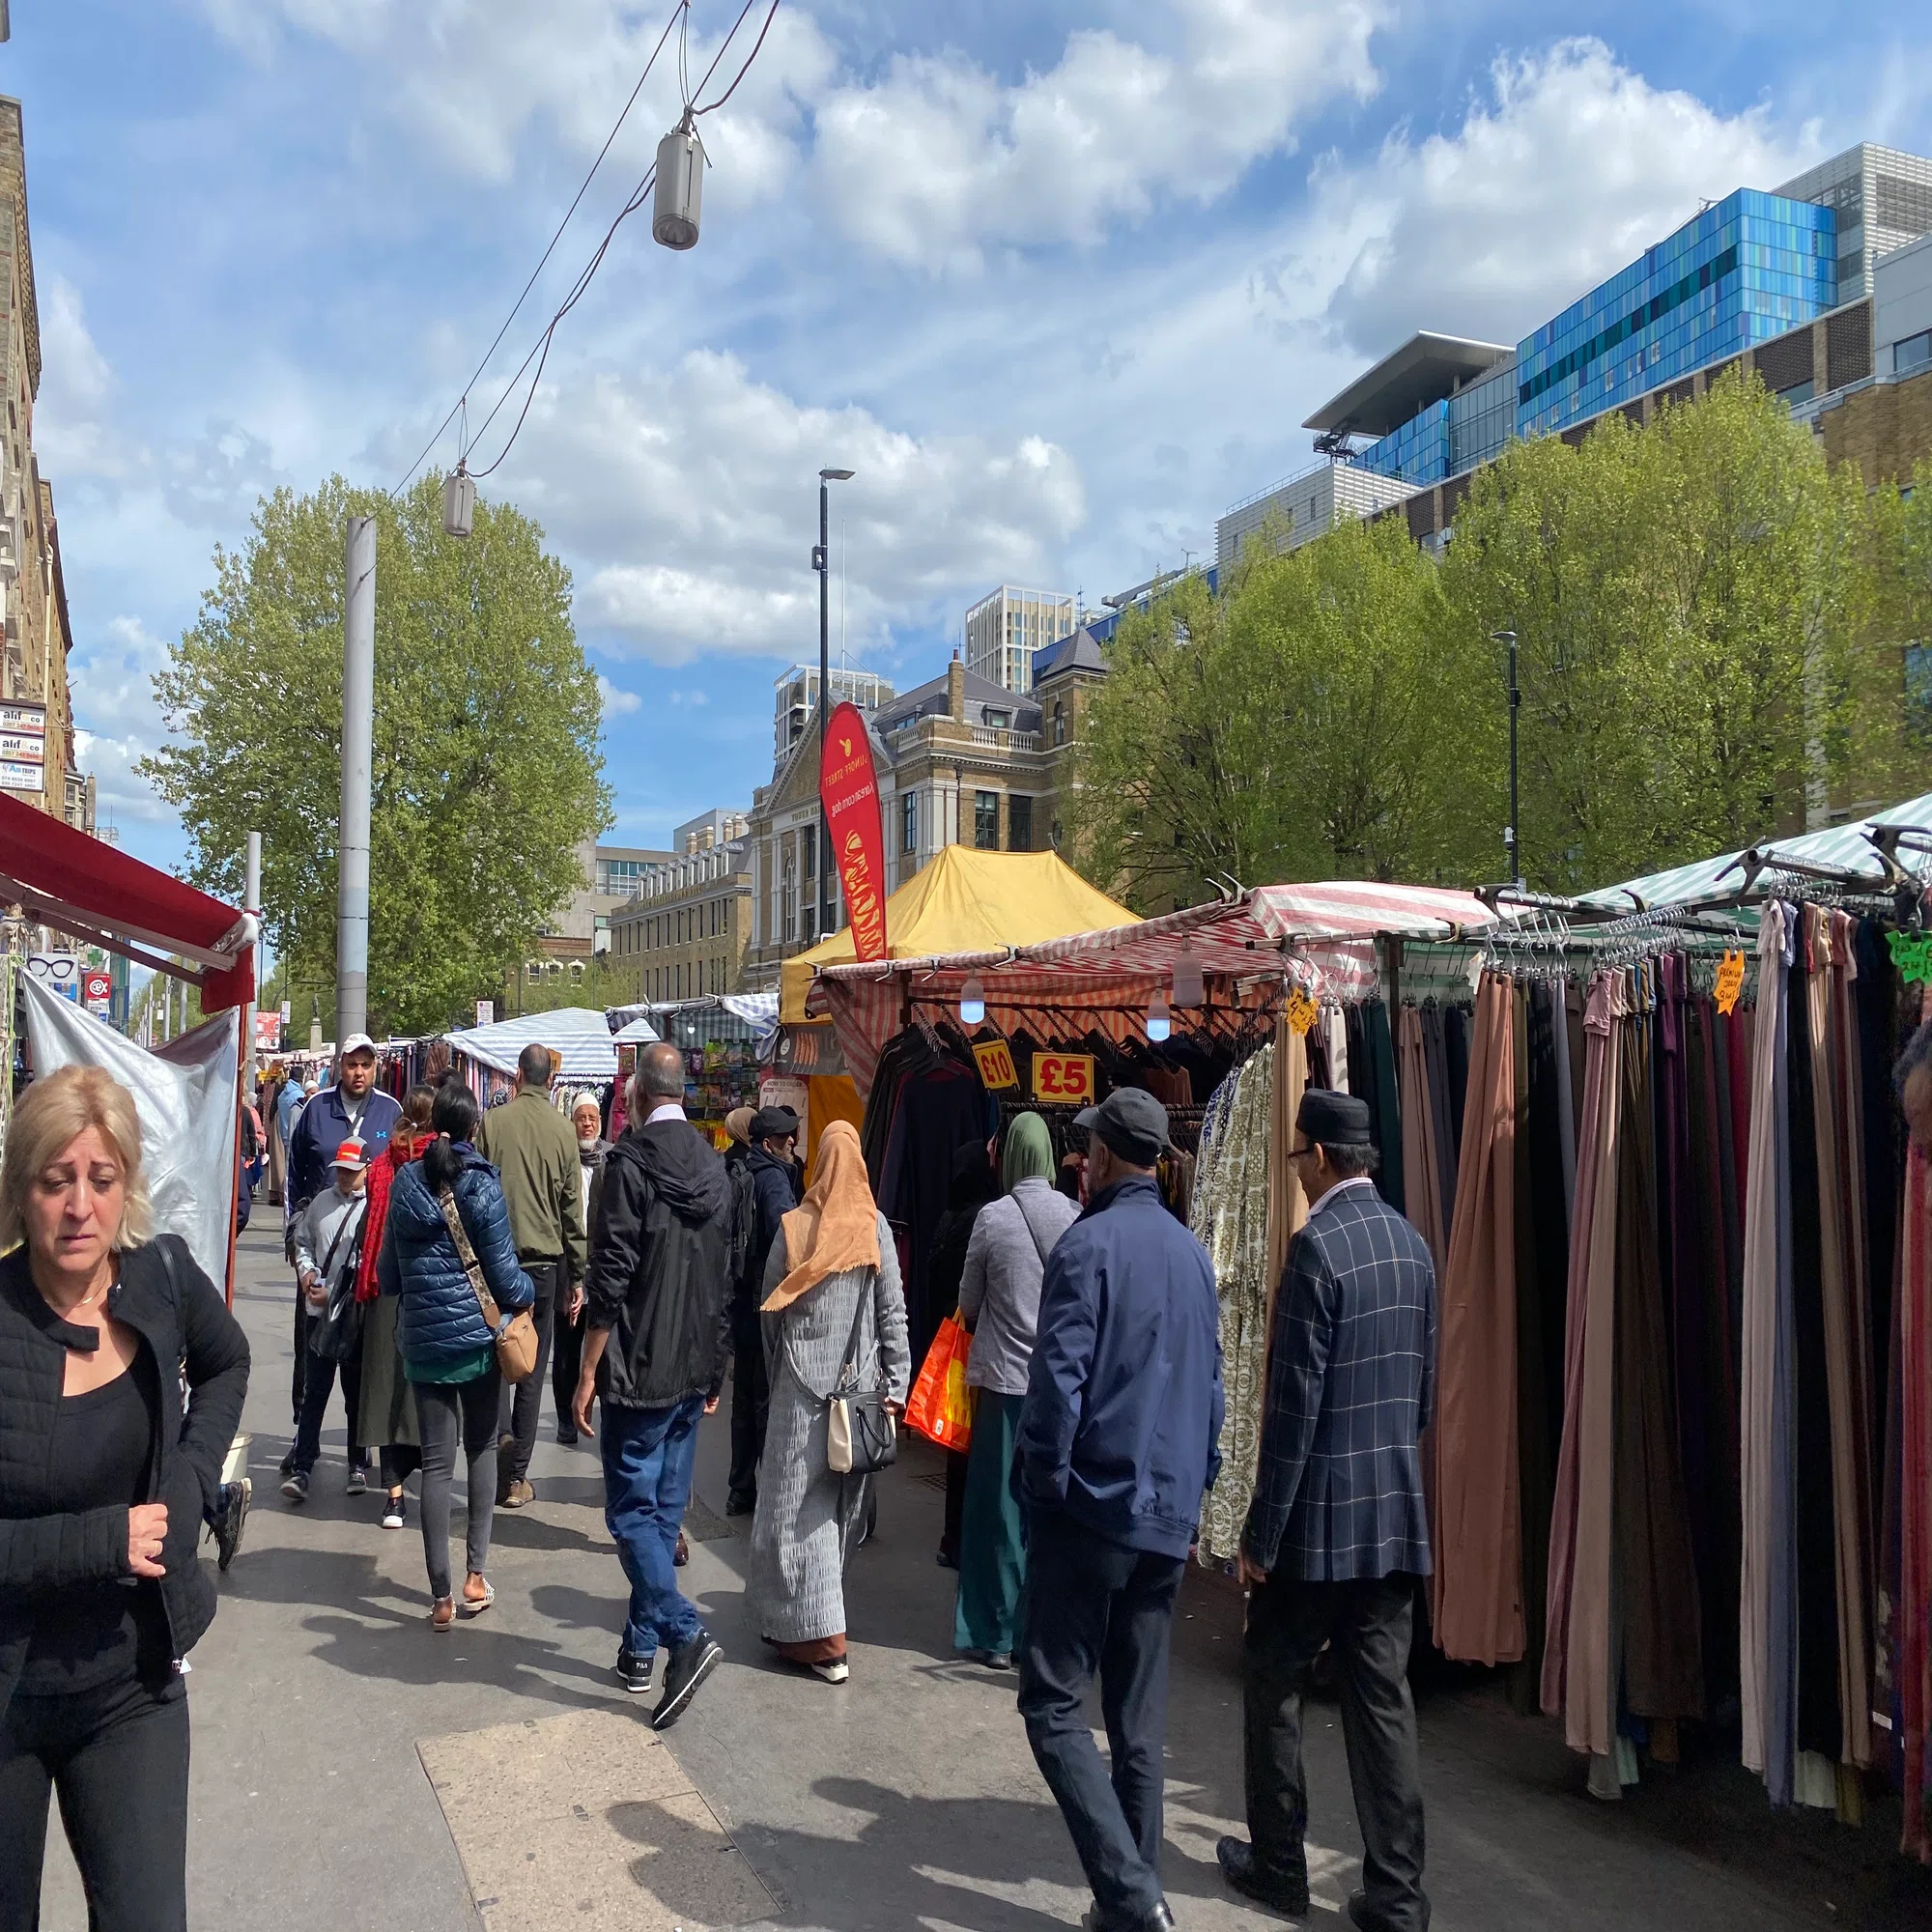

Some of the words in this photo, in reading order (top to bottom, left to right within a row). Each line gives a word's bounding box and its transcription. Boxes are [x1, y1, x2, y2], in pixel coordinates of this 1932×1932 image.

[1290, 1001, 1298, 1016] 4
[980, 1050, 1011, 1084] £10
[1039, 1058, 1088, 1094] £5
